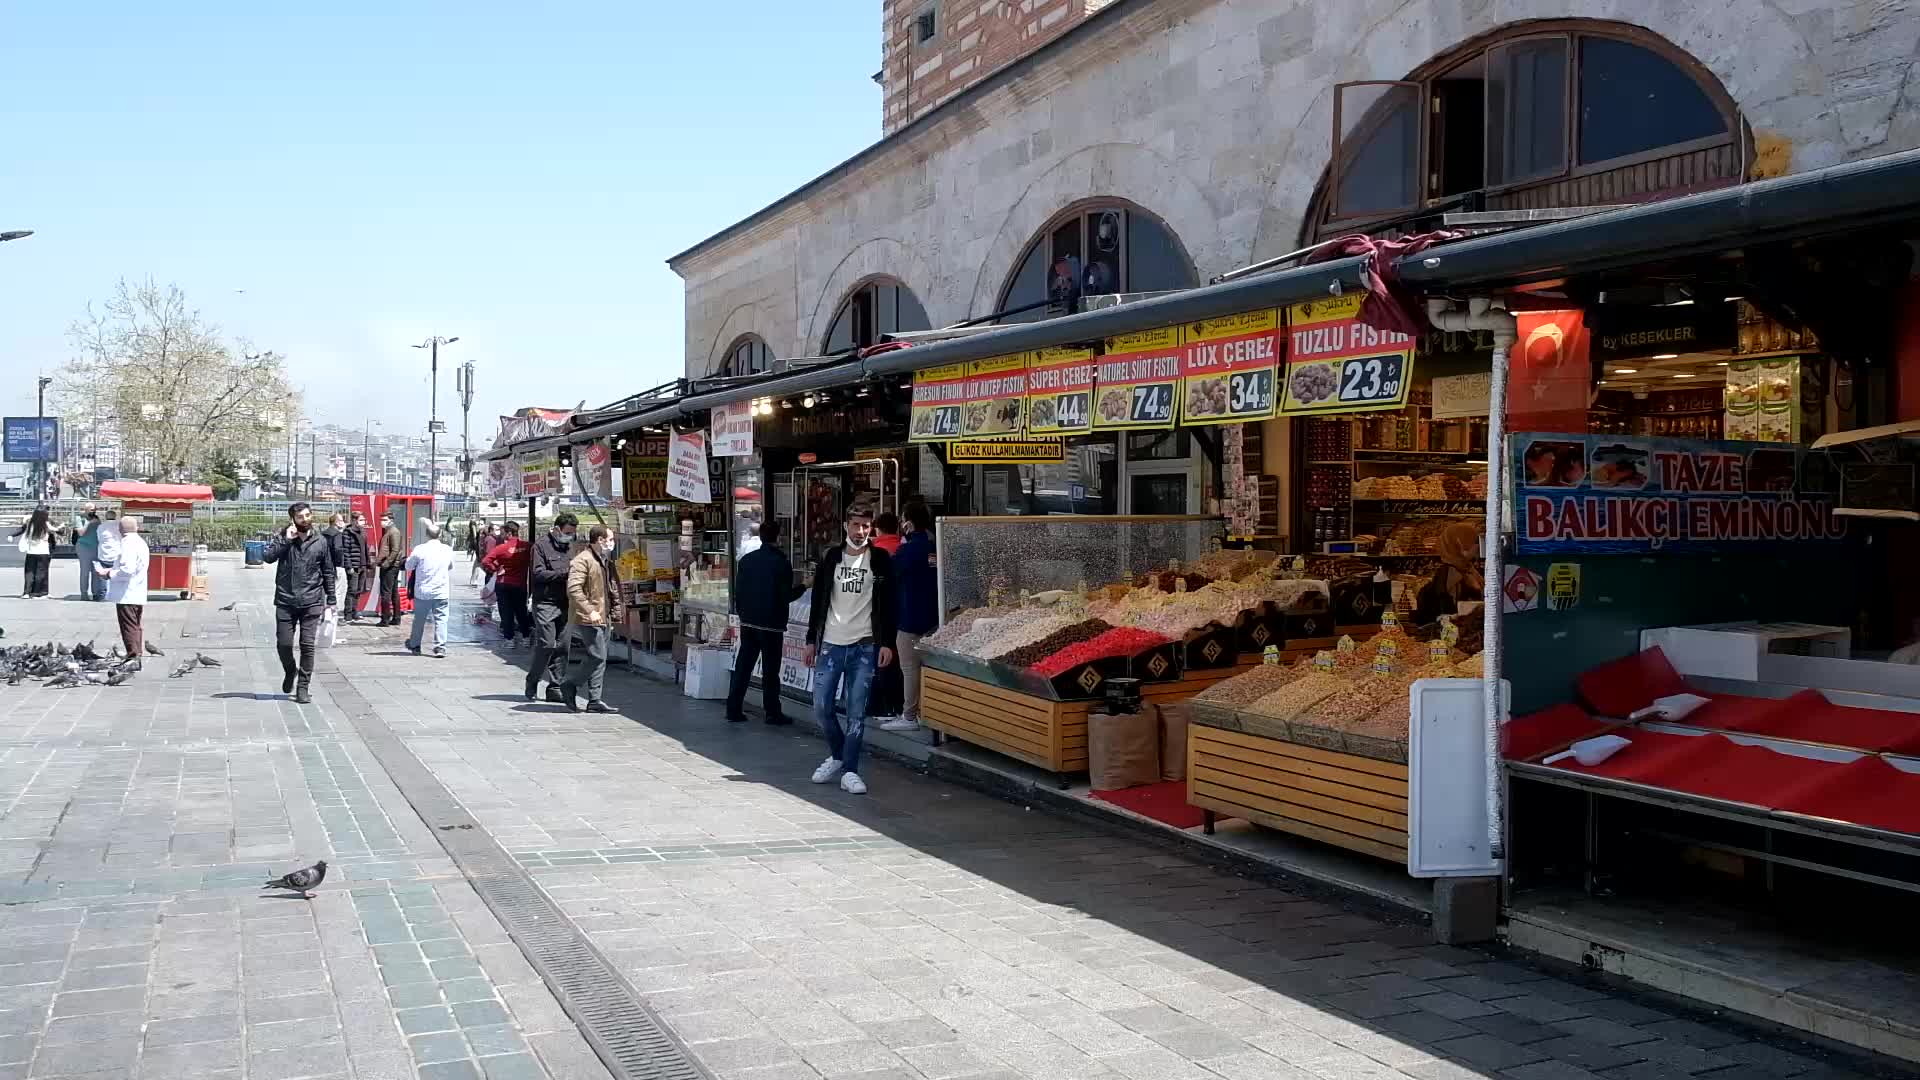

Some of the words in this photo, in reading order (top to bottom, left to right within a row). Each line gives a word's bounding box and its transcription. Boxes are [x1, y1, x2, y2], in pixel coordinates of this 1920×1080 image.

[1188, 343, 1218, 368] LÜX
[1224, 335, 1275, 369] ÇEREZ
[1293, 326, 1344, 355] TUZLU
[1030, 368, 1061, 390] SÜPER
[1063, 364, 1092, 391] ÇEREZ
[1097, 361, 1130, 385] NATUREL
[1153, 355, 1180, 377] FISTIK
[942, 383, 964, 401] FINDIK
[966, 378, 979, 399] LÜX
[980, 378, 1001, 398] ANTEP
[1002, 375, 1025, 396] FISTIK
[982, 444, 1060, 456] KULLANILMAMAKTADIR
[1655, 451, 1744, 493] TAZE
[1526, 495, 1681, 550] BALIKÇI
